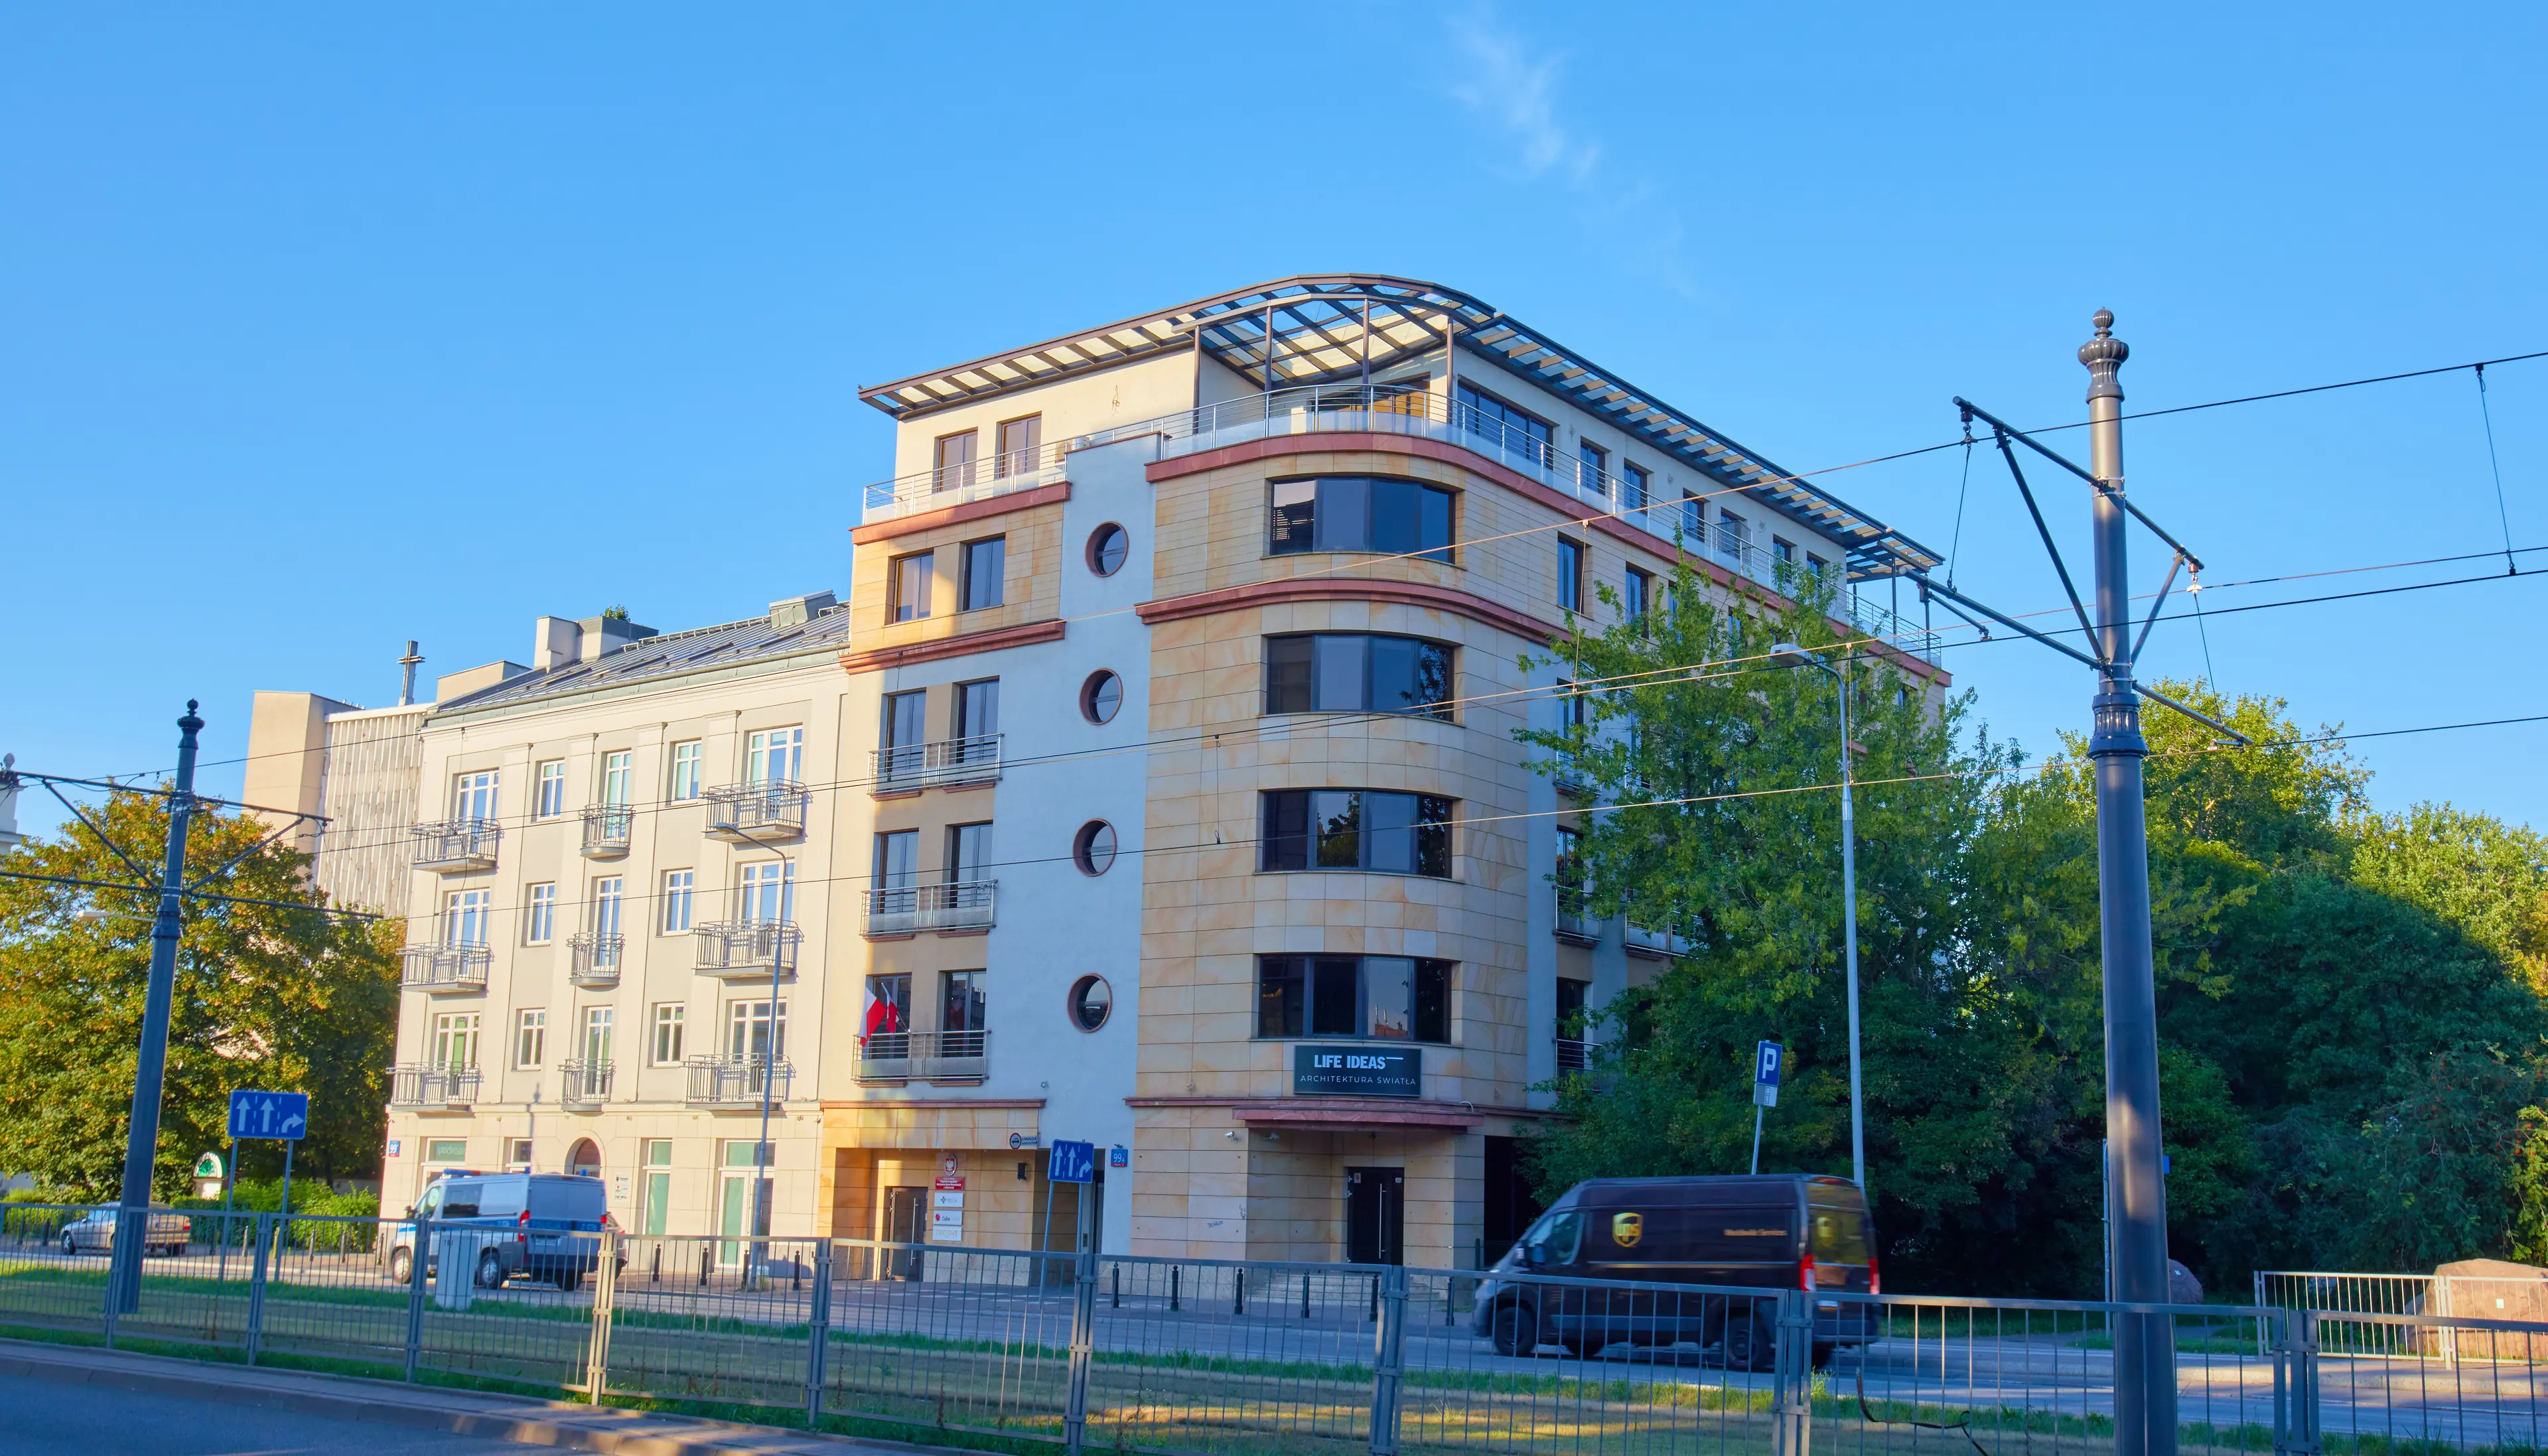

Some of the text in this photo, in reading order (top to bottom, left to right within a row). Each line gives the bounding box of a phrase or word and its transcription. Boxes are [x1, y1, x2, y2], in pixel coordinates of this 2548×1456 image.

[1314, 1054, 1386, 1069] LIFE IDEAS
[1762, 1047, 1777, 1079] P
[1300, 1075, 1416, 1085] ARCHITEKTURA ŚWIATŁA
